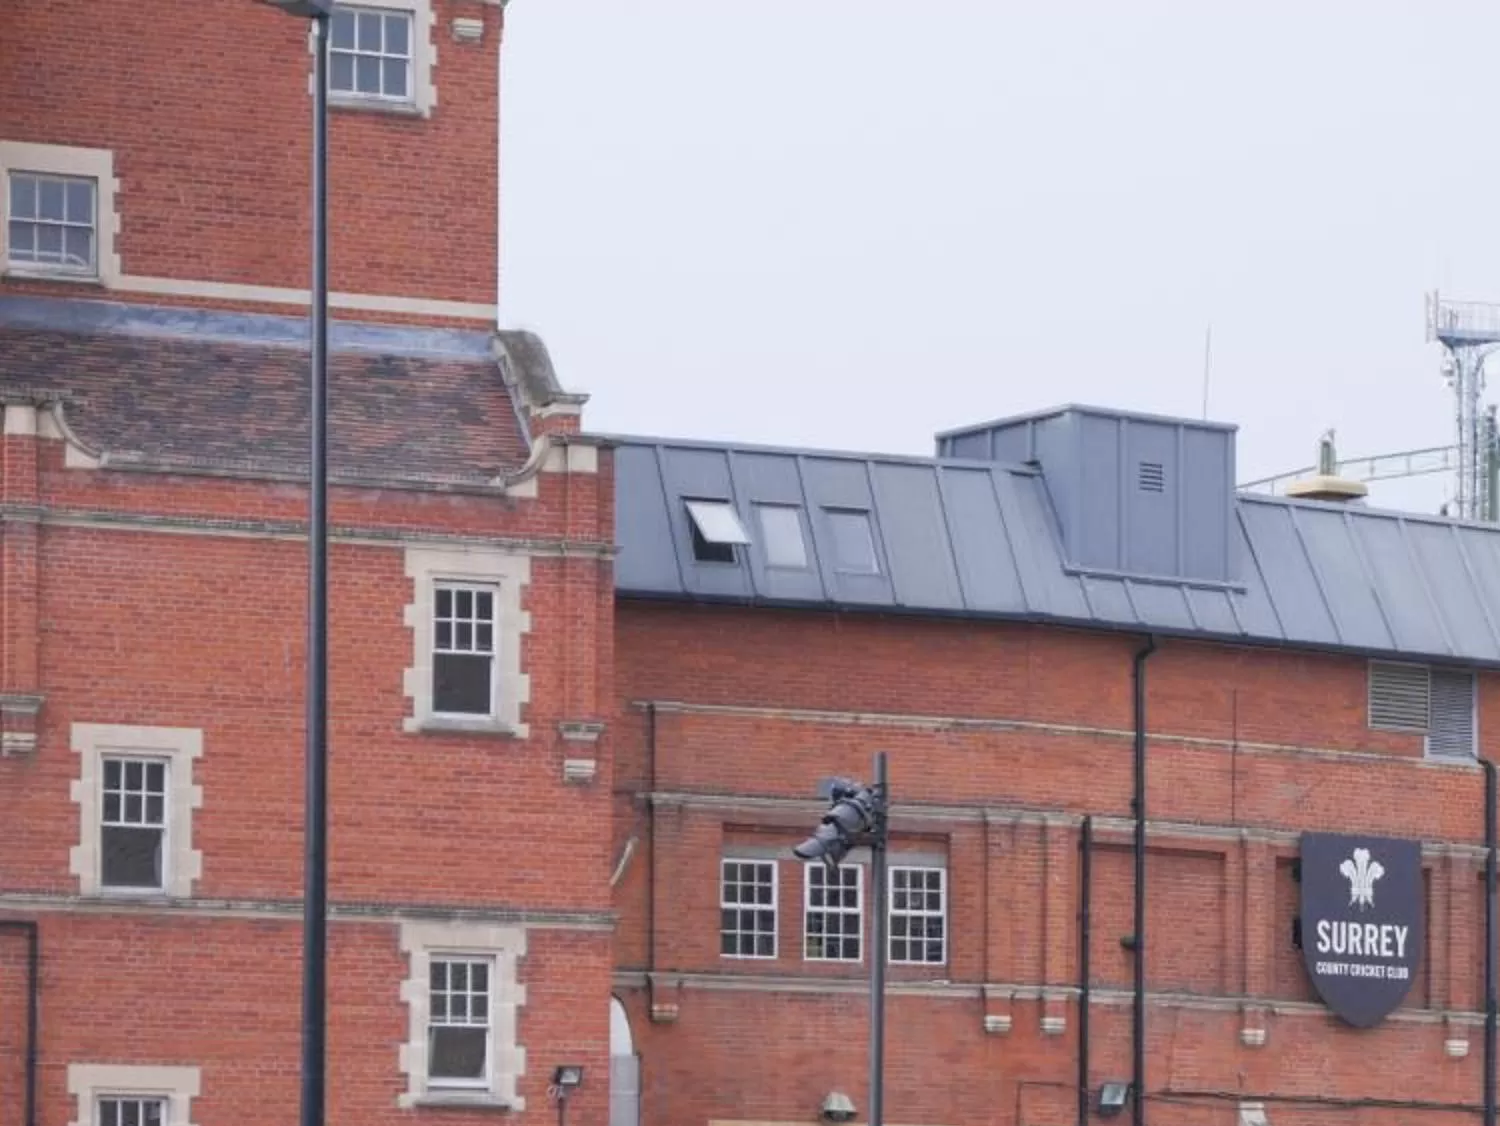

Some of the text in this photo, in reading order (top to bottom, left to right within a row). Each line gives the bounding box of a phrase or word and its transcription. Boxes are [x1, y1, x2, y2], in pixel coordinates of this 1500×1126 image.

[1316, 919, 1408, 957] SURREY
[1315, 961, 1409, 979] COUNTY CRICKET CLUB
